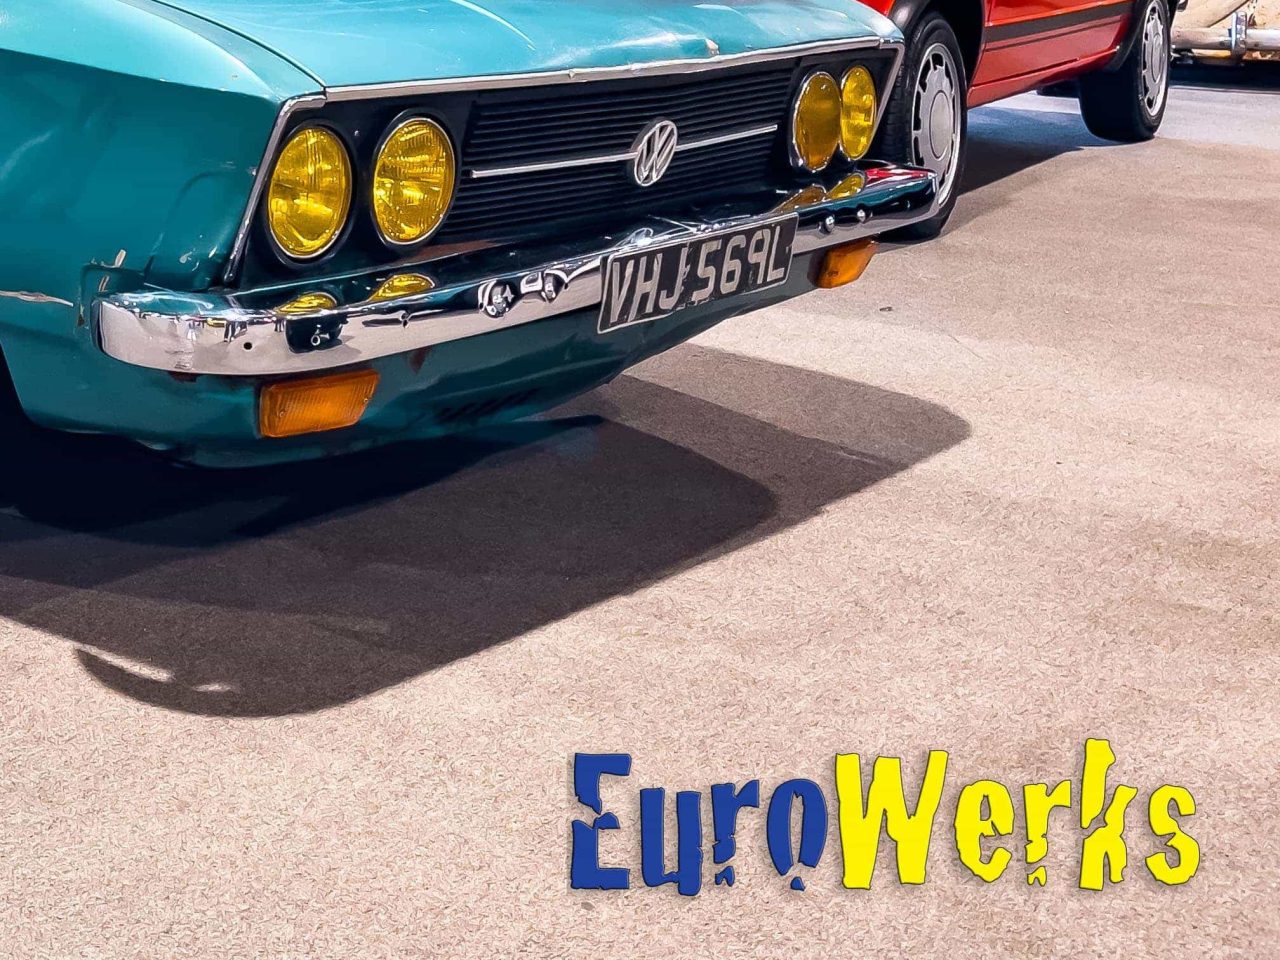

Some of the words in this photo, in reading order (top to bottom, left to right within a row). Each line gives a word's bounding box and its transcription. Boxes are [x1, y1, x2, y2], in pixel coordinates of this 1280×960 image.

[634, 120, 678, 187] VW
[610, 247, 689, 323] VHJ
[691, 225, 785, 302] 569L
